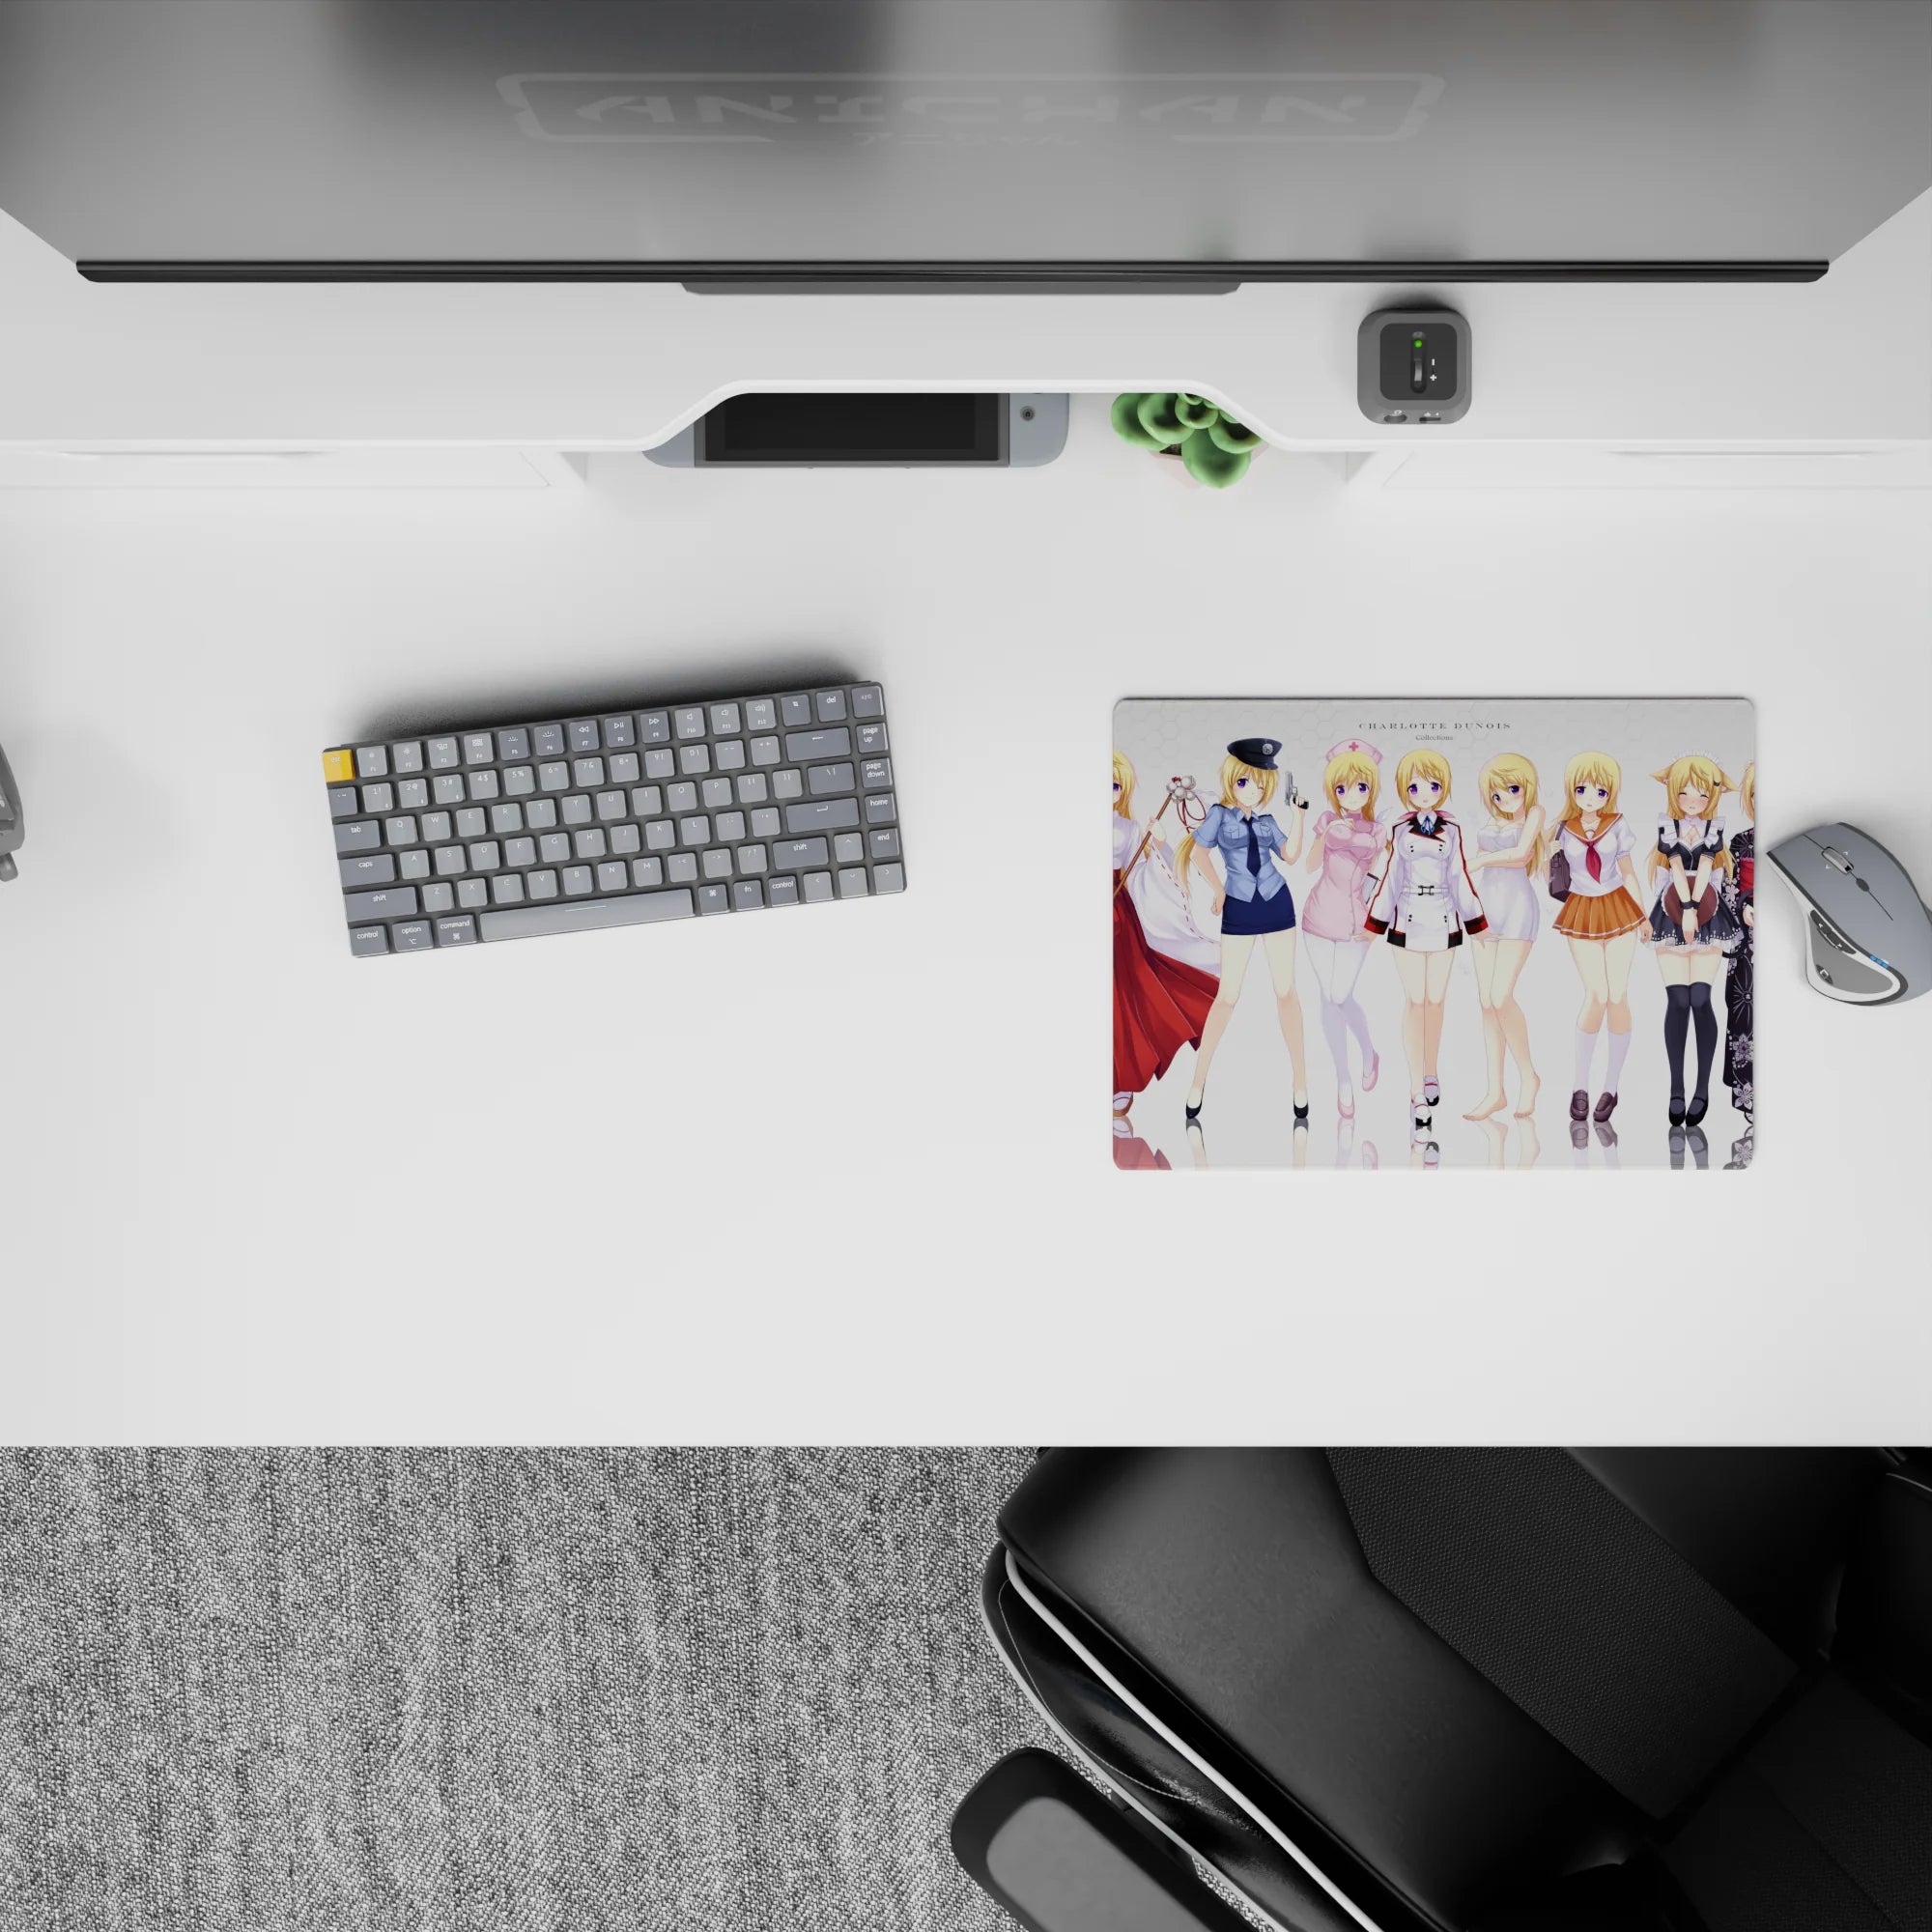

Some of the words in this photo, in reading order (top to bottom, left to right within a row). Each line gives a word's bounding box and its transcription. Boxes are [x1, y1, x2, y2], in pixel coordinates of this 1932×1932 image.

[575, 96, 1366, 123] ANICHAN
[866, 762, 882, 771] page
[772, 880, 794, 889] control
[372, 894, 387, 902] shift
[440, 920, 469, 929] command
[401, 926, 422, 935] option
